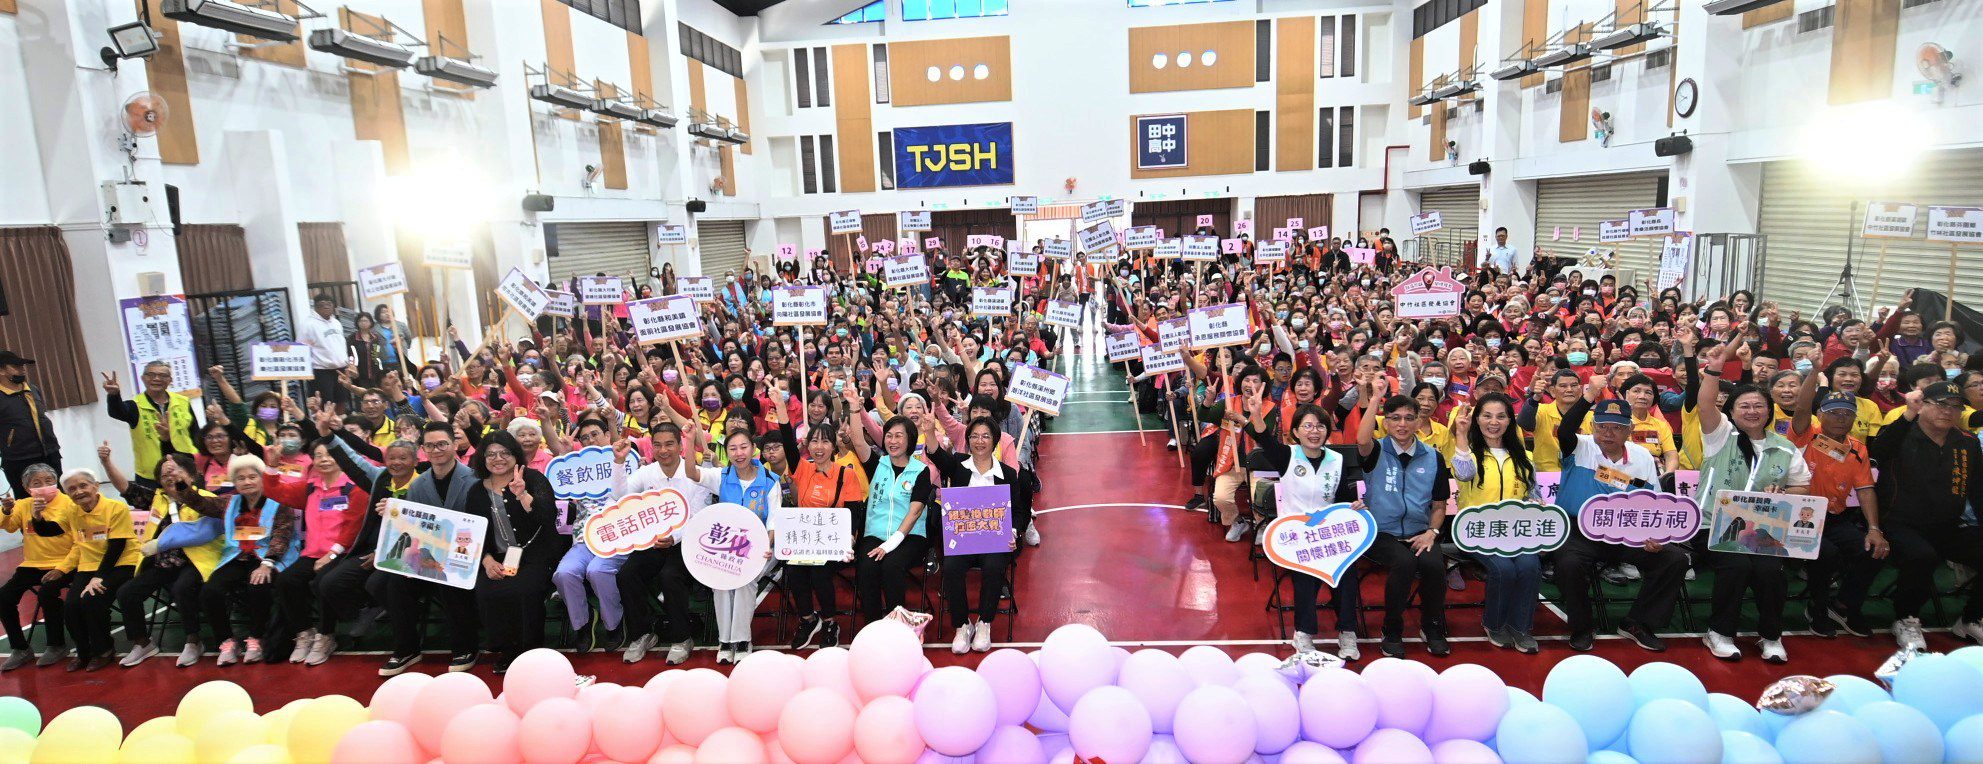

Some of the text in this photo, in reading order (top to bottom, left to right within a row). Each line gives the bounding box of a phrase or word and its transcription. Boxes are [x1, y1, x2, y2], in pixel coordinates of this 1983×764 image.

[1148, 123, 1176, 139] 田中
[1148, 138, 1176, 154] 高中
[906, 142, 997, 172] TJSH
[971, 237, 982, 245] 10
[1278, 231, 1288, 239] 14
[1313, 229, 1324, 238] 13
[928, 238, 937, 247] 29
[991, 238, 1000, 246] 16
[1228, 242, 1235, 252] 2
[782, 247, 792, 255] 12
[1361, 251, 1367, 261] 1
[643, 312, 687, 325] 彰化縣和美鎮
[596, 500, 680, 543] 電話問安
[1592, 508, 1688, 530] 關懷訪視
[1304, 521, 1361, 545] 社區照顧
[1464, 519, 1557, 540] 健康促進
[708, 522, 751, 558] 彰化
[1296, 539, 1353, 564] 關懷據點
[695, 553, 742, 573] CHANGHUA
